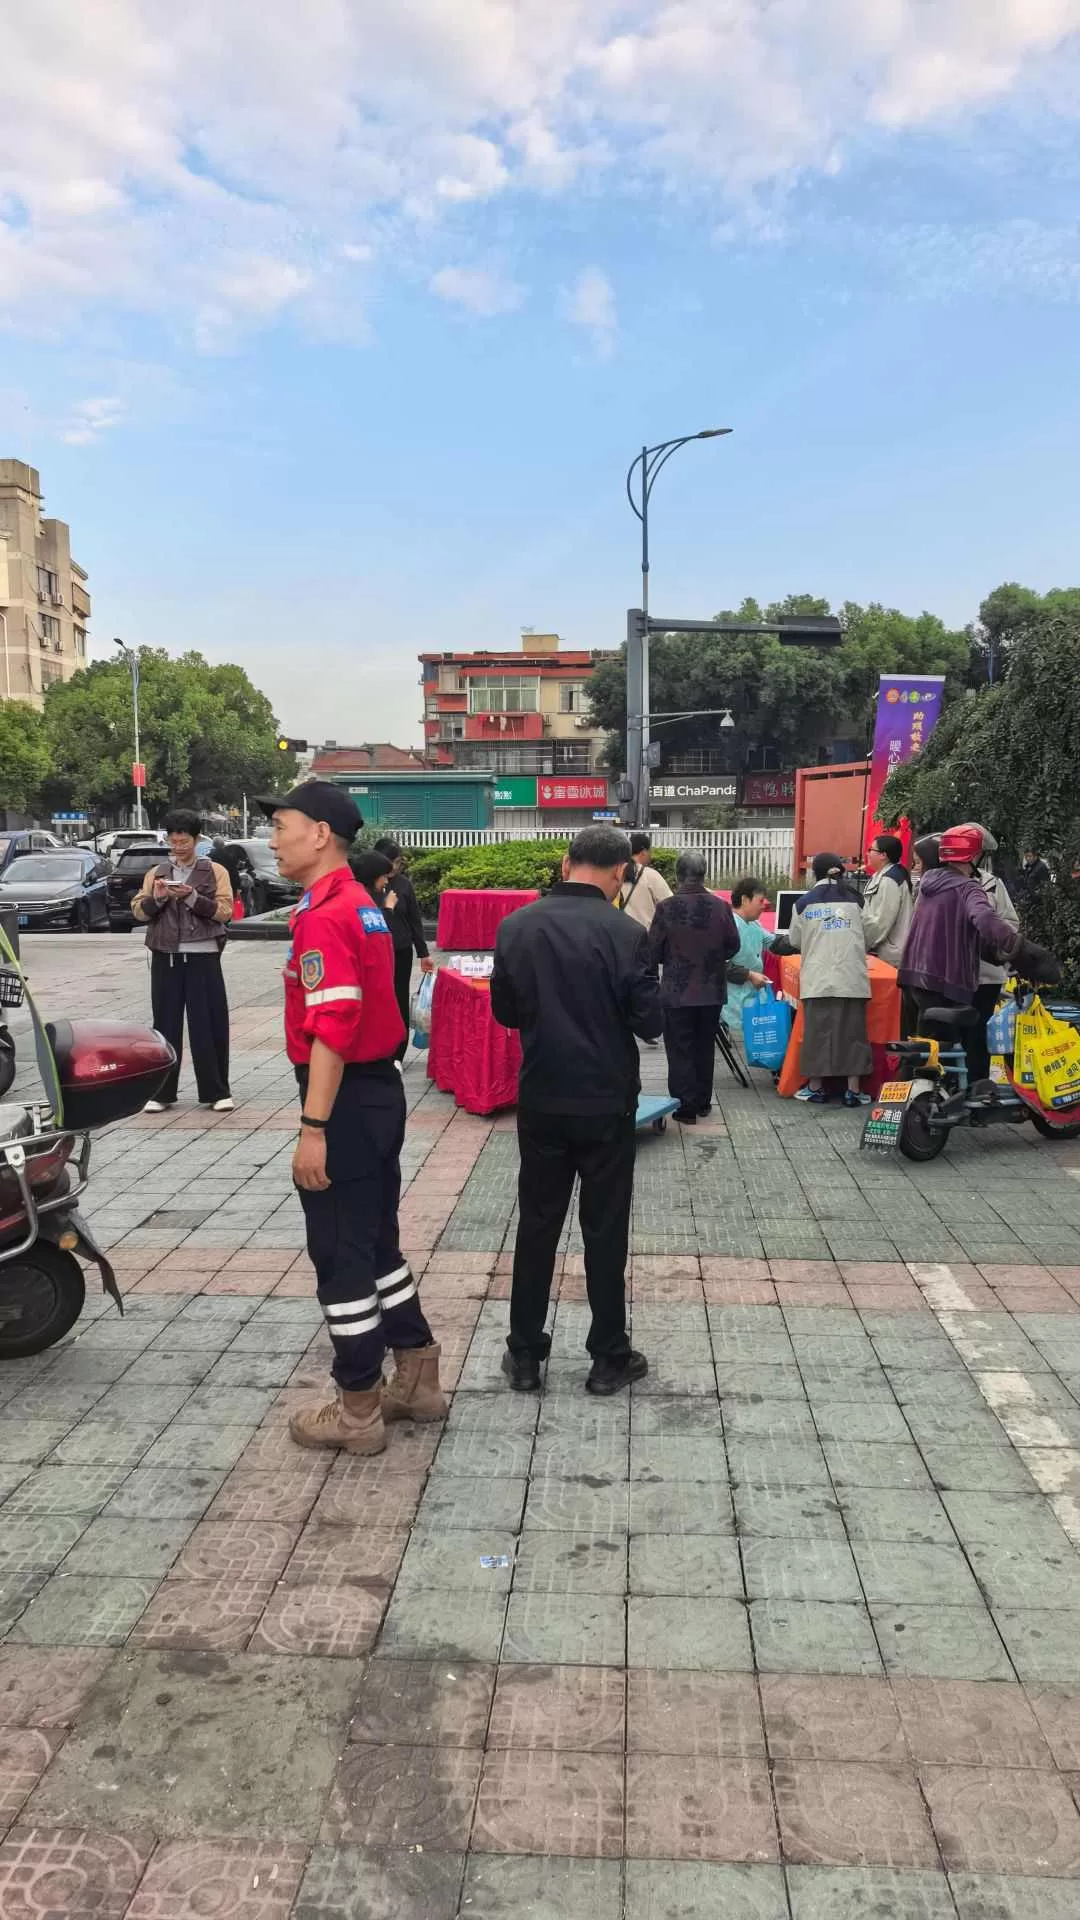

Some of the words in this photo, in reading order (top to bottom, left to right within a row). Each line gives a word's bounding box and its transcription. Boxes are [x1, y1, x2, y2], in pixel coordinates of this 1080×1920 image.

[553, 785, 605, 799] 蜜雪冰城
[881, 1109, 903, 1124] 雅迪
